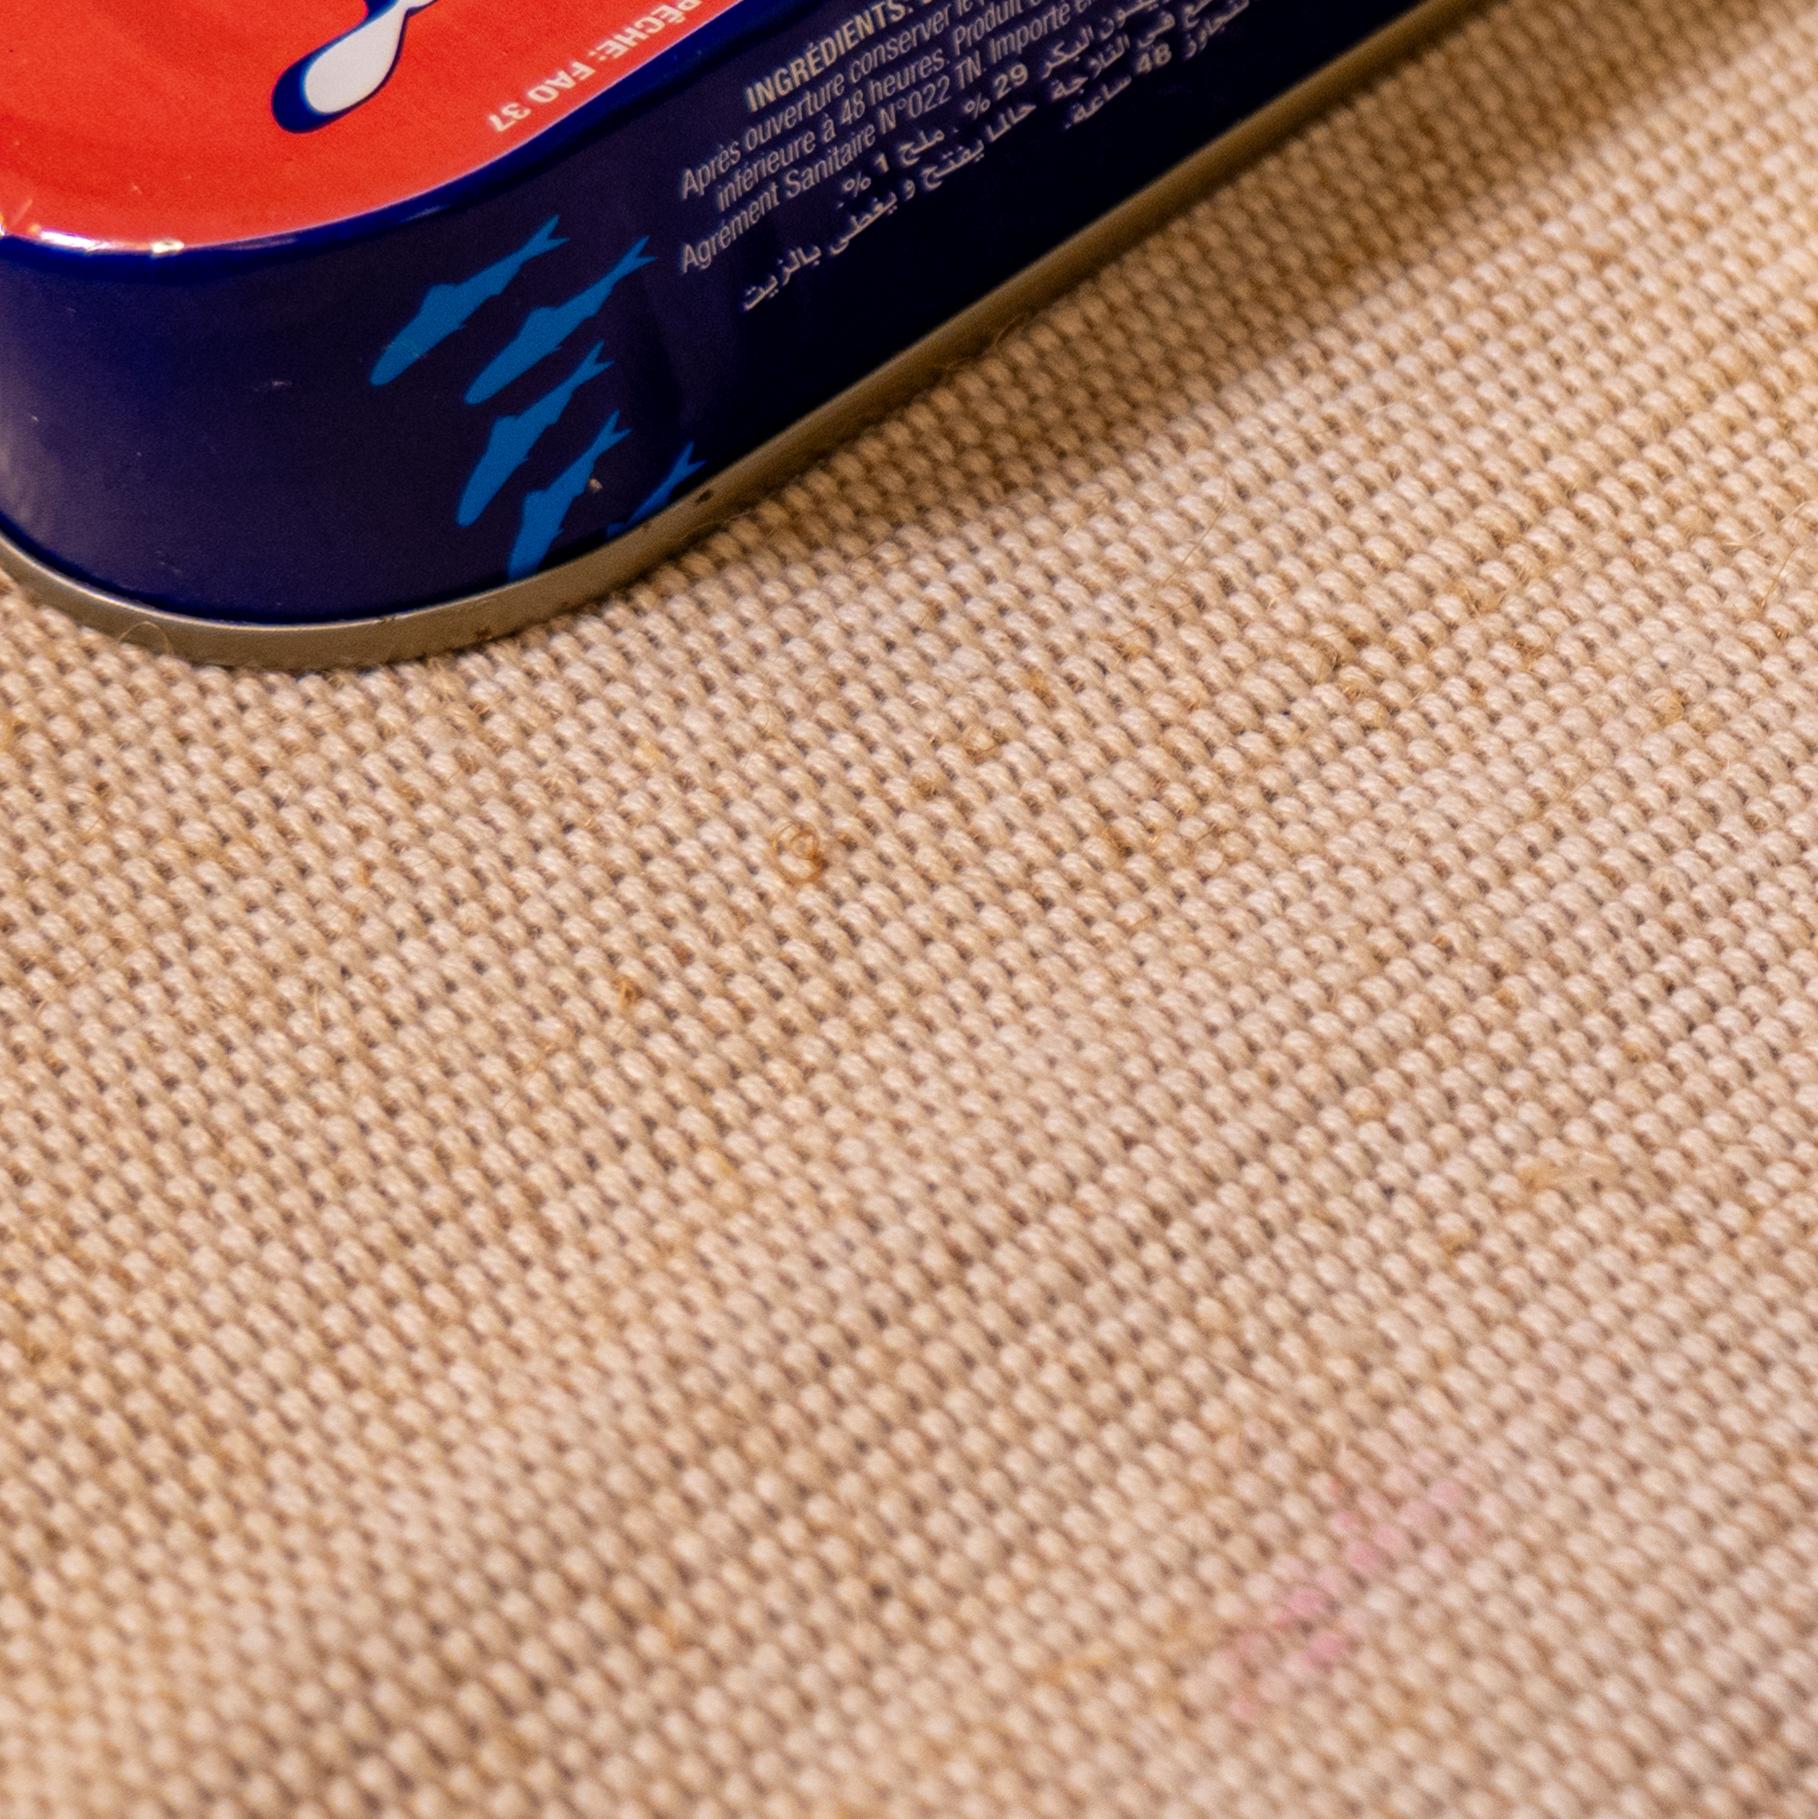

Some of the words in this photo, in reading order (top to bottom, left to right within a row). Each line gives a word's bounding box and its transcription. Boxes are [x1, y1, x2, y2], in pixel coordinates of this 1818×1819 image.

[489, 103, 529, 131] 37
[527, 61, 594, 102] FAO
[682, 141, 740, 198] Après
[744, 73, 844, 150] ouverture
[850, 3, 948, 83] conserver
[993, 63, 1027, 98] 29
[717, 131, 815, 210] inférieure
[821, 113, 835, 142] à
[840, 89, 864, 123] 48
[869, 48, 949, 104] heures.
[681, 182, 778, 272] Agrément
[784, 124, 874, 197] Sanitaire
